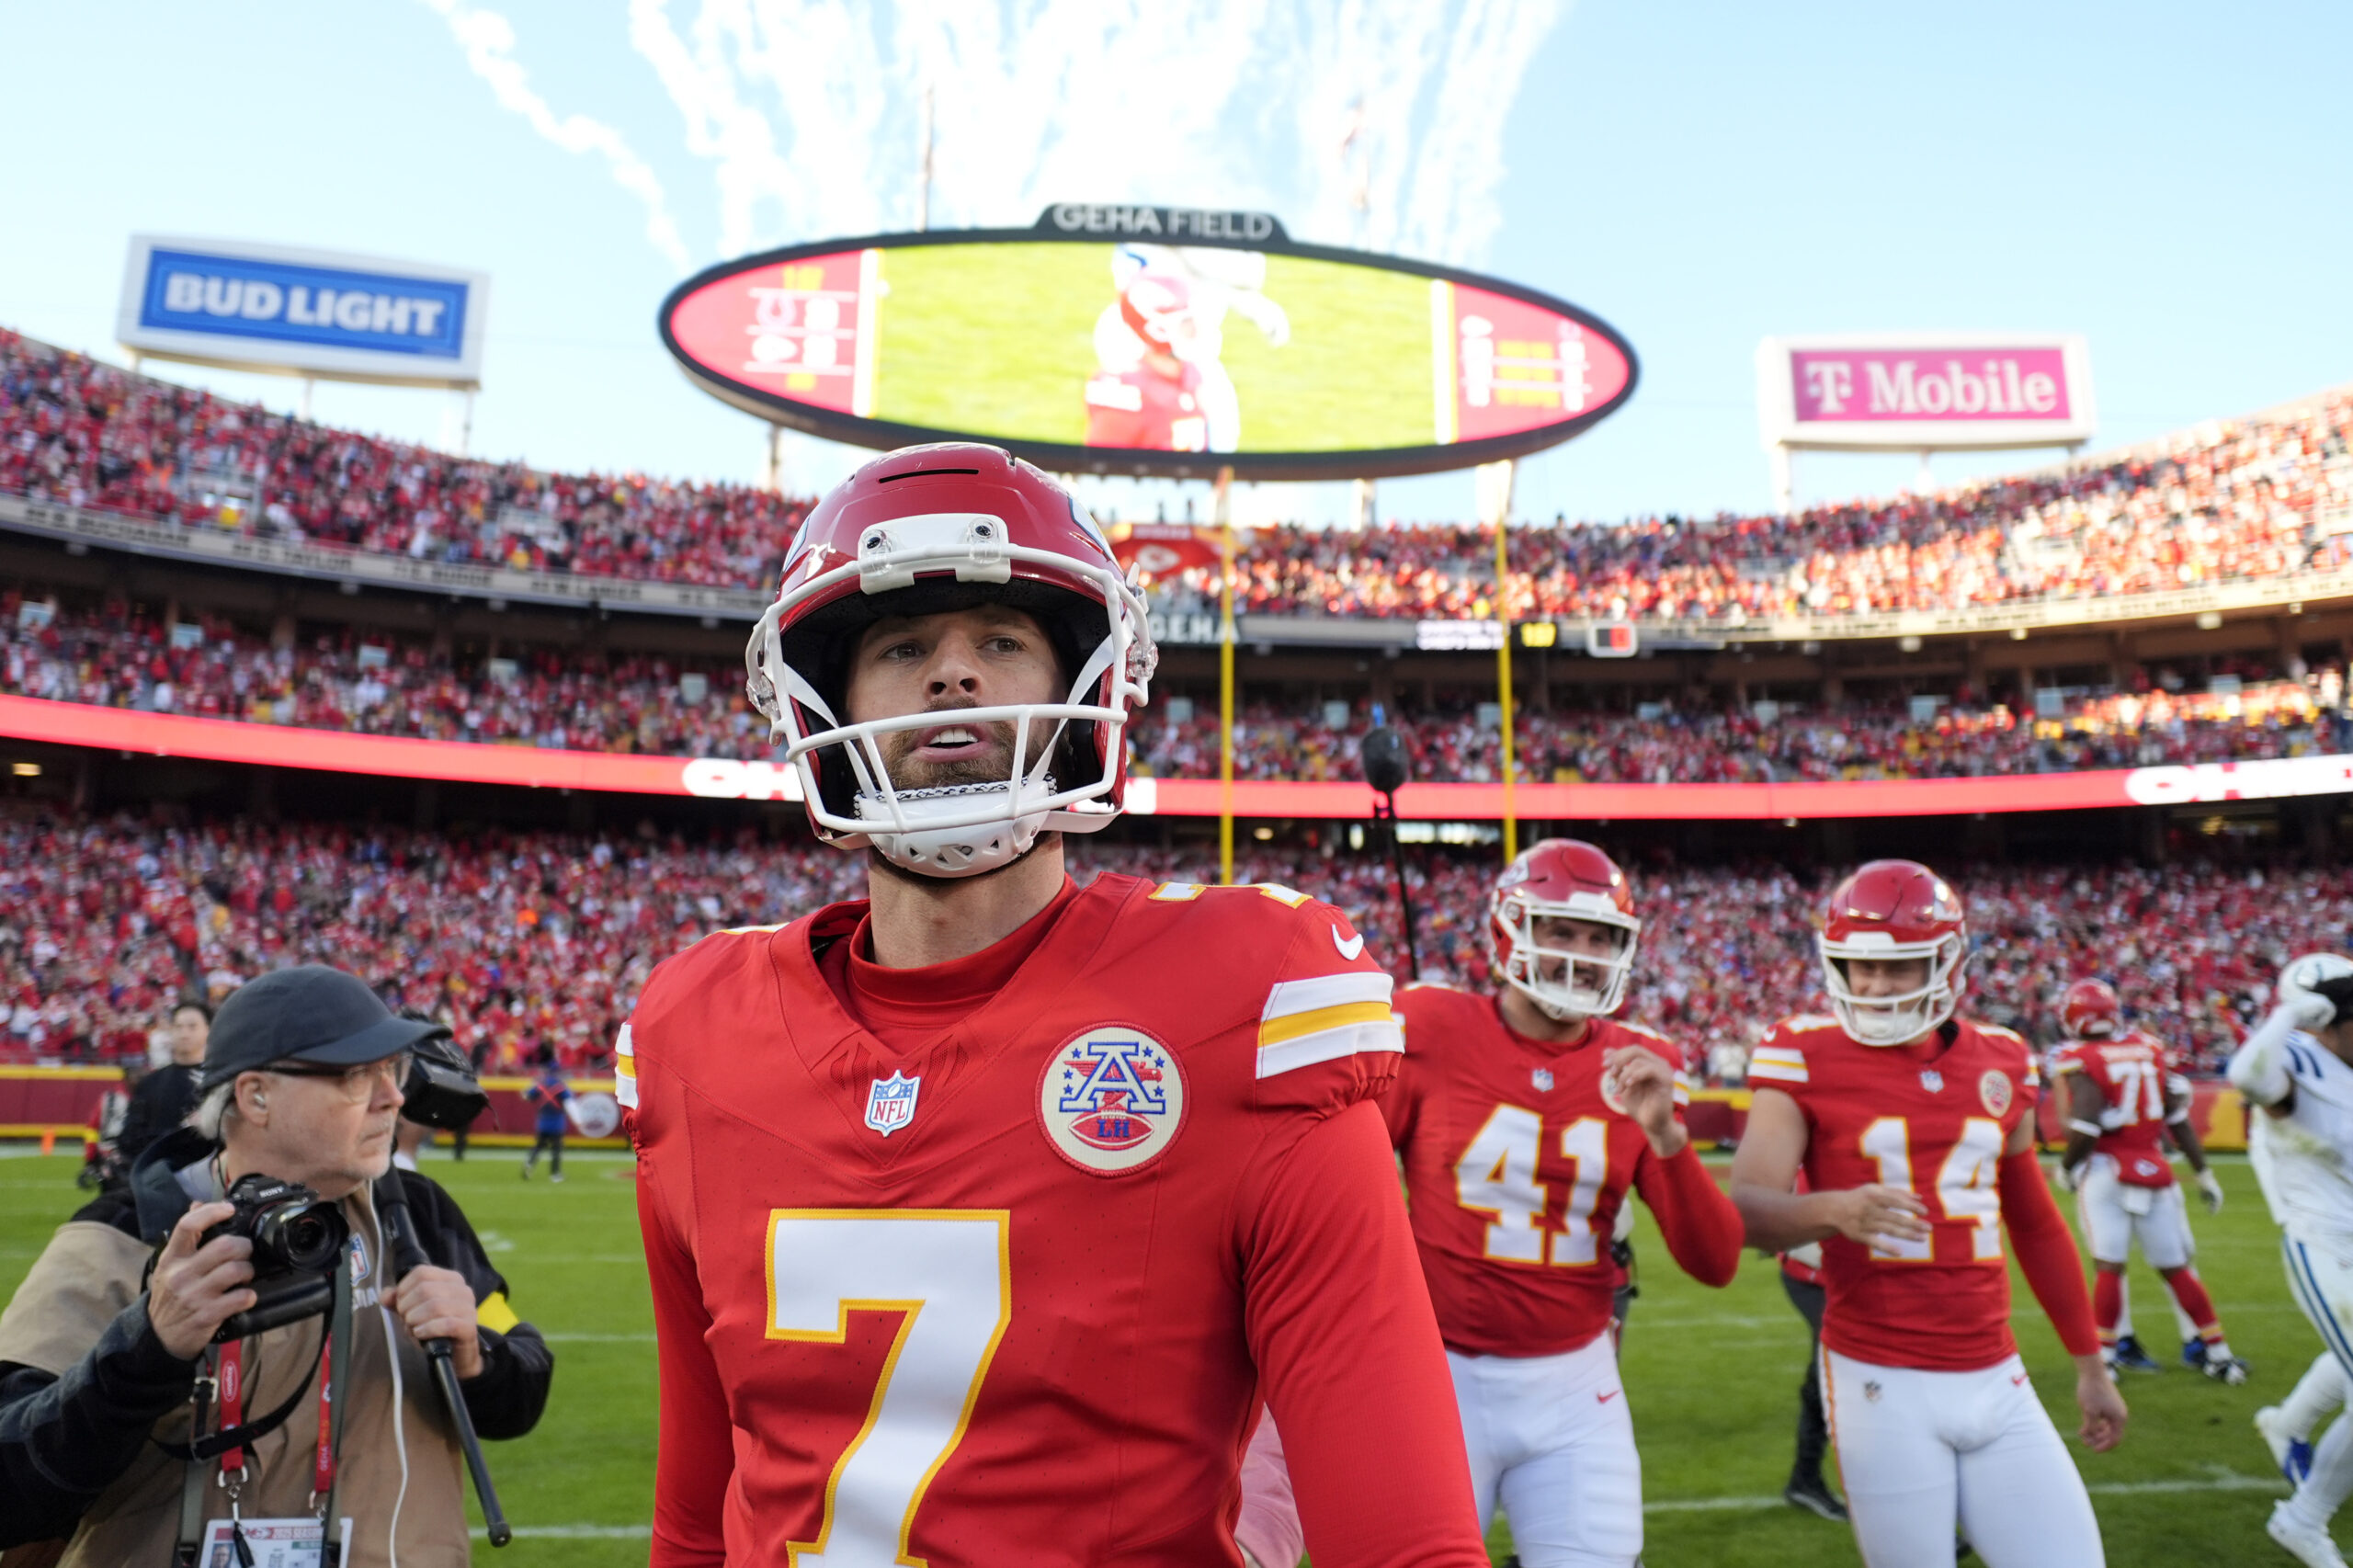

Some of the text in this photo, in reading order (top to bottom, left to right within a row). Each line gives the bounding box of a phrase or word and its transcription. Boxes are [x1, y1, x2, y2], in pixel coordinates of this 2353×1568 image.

[1052, 204, 1274, 241] GEHA FIELD
[165, 272, 445, 336] BUD LIGHT
[1864, 358, 2058, 414] Mobile
[873, 1099, 906, 1124] NFL
[2106, 1061, 2165, 1127] 71
[1097, 1119, 1130, 1138] LH
[259, 1186, 285, 1199] SONY
[1454, 1103, 1608, 1267] 41
[1859, 1116, 2006, 1263] 14
[765, 1208, 1011, 1568] 7
